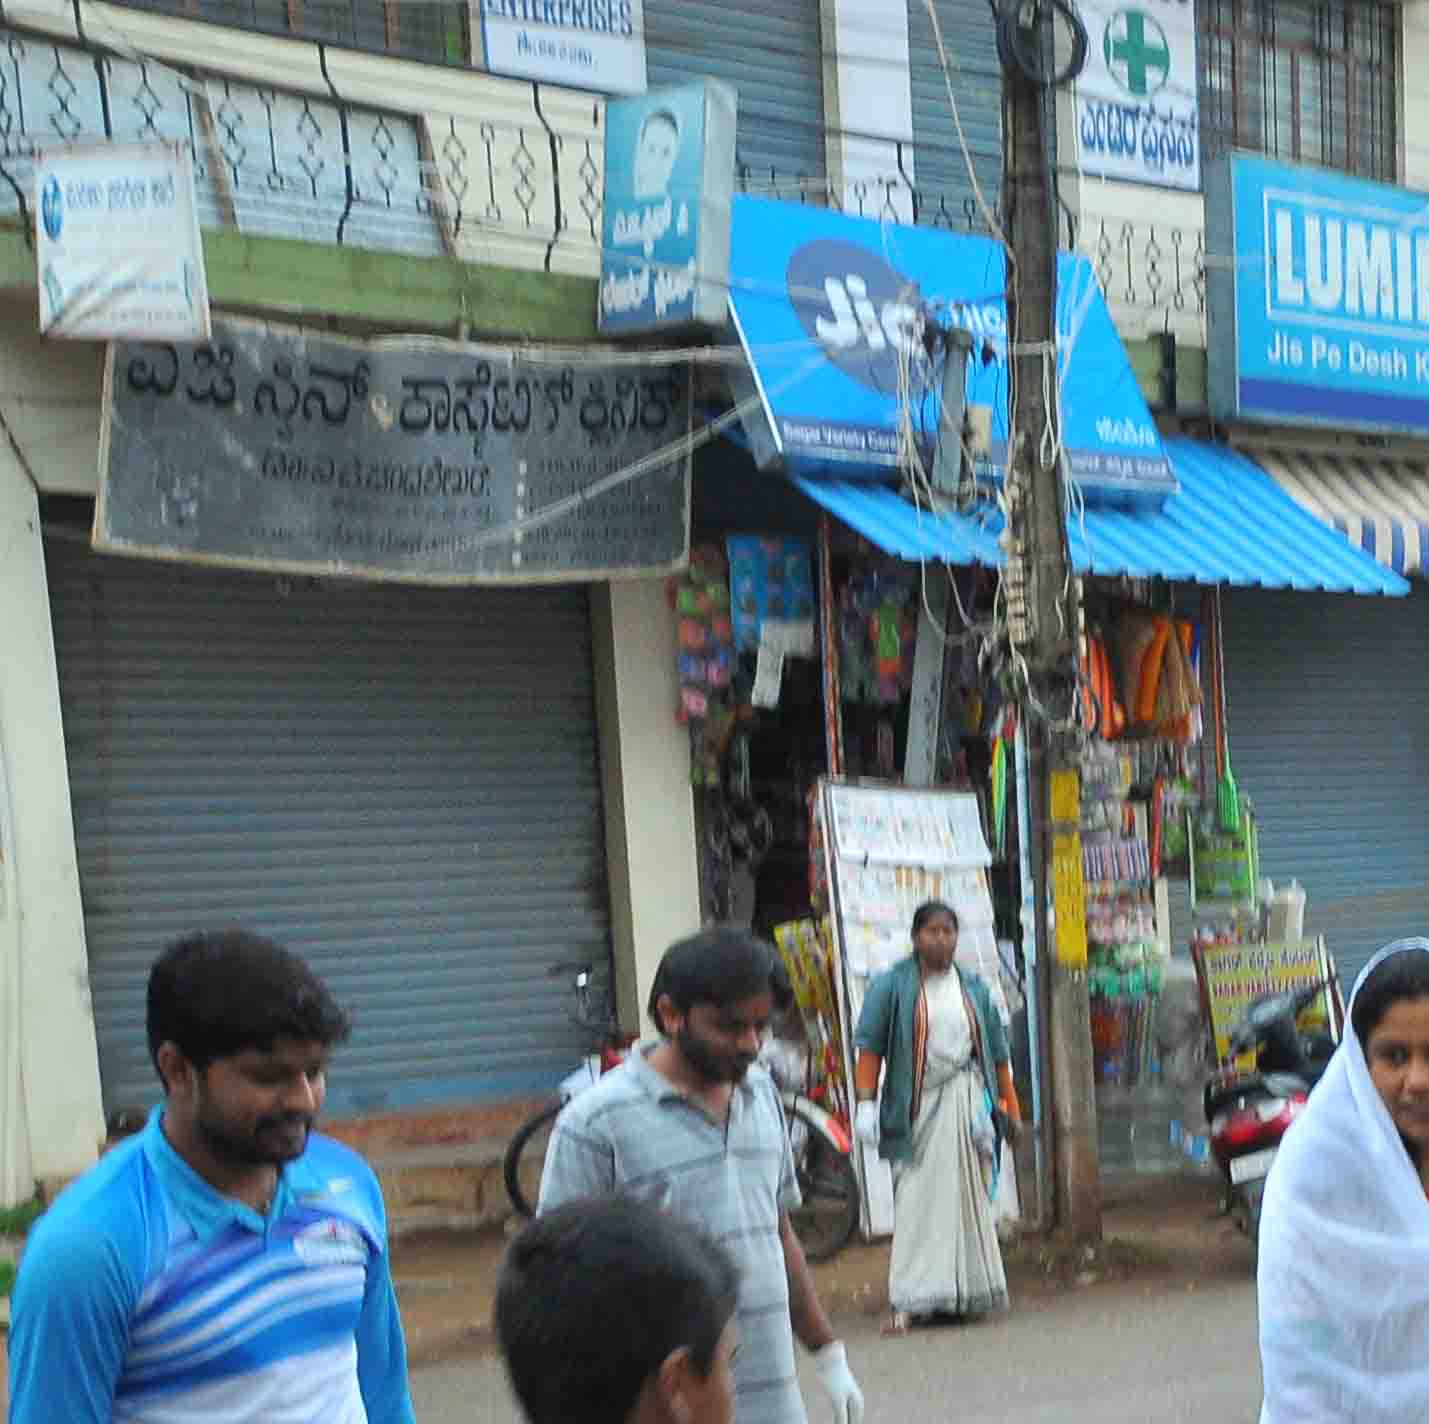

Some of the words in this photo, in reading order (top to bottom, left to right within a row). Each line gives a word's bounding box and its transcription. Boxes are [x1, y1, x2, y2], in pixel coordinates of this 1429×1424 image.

[1266, 331, 1303, 365] Jis
[1310, 336, 1342, 367] Pe
[1349, 345, 1408, 381] Desh
